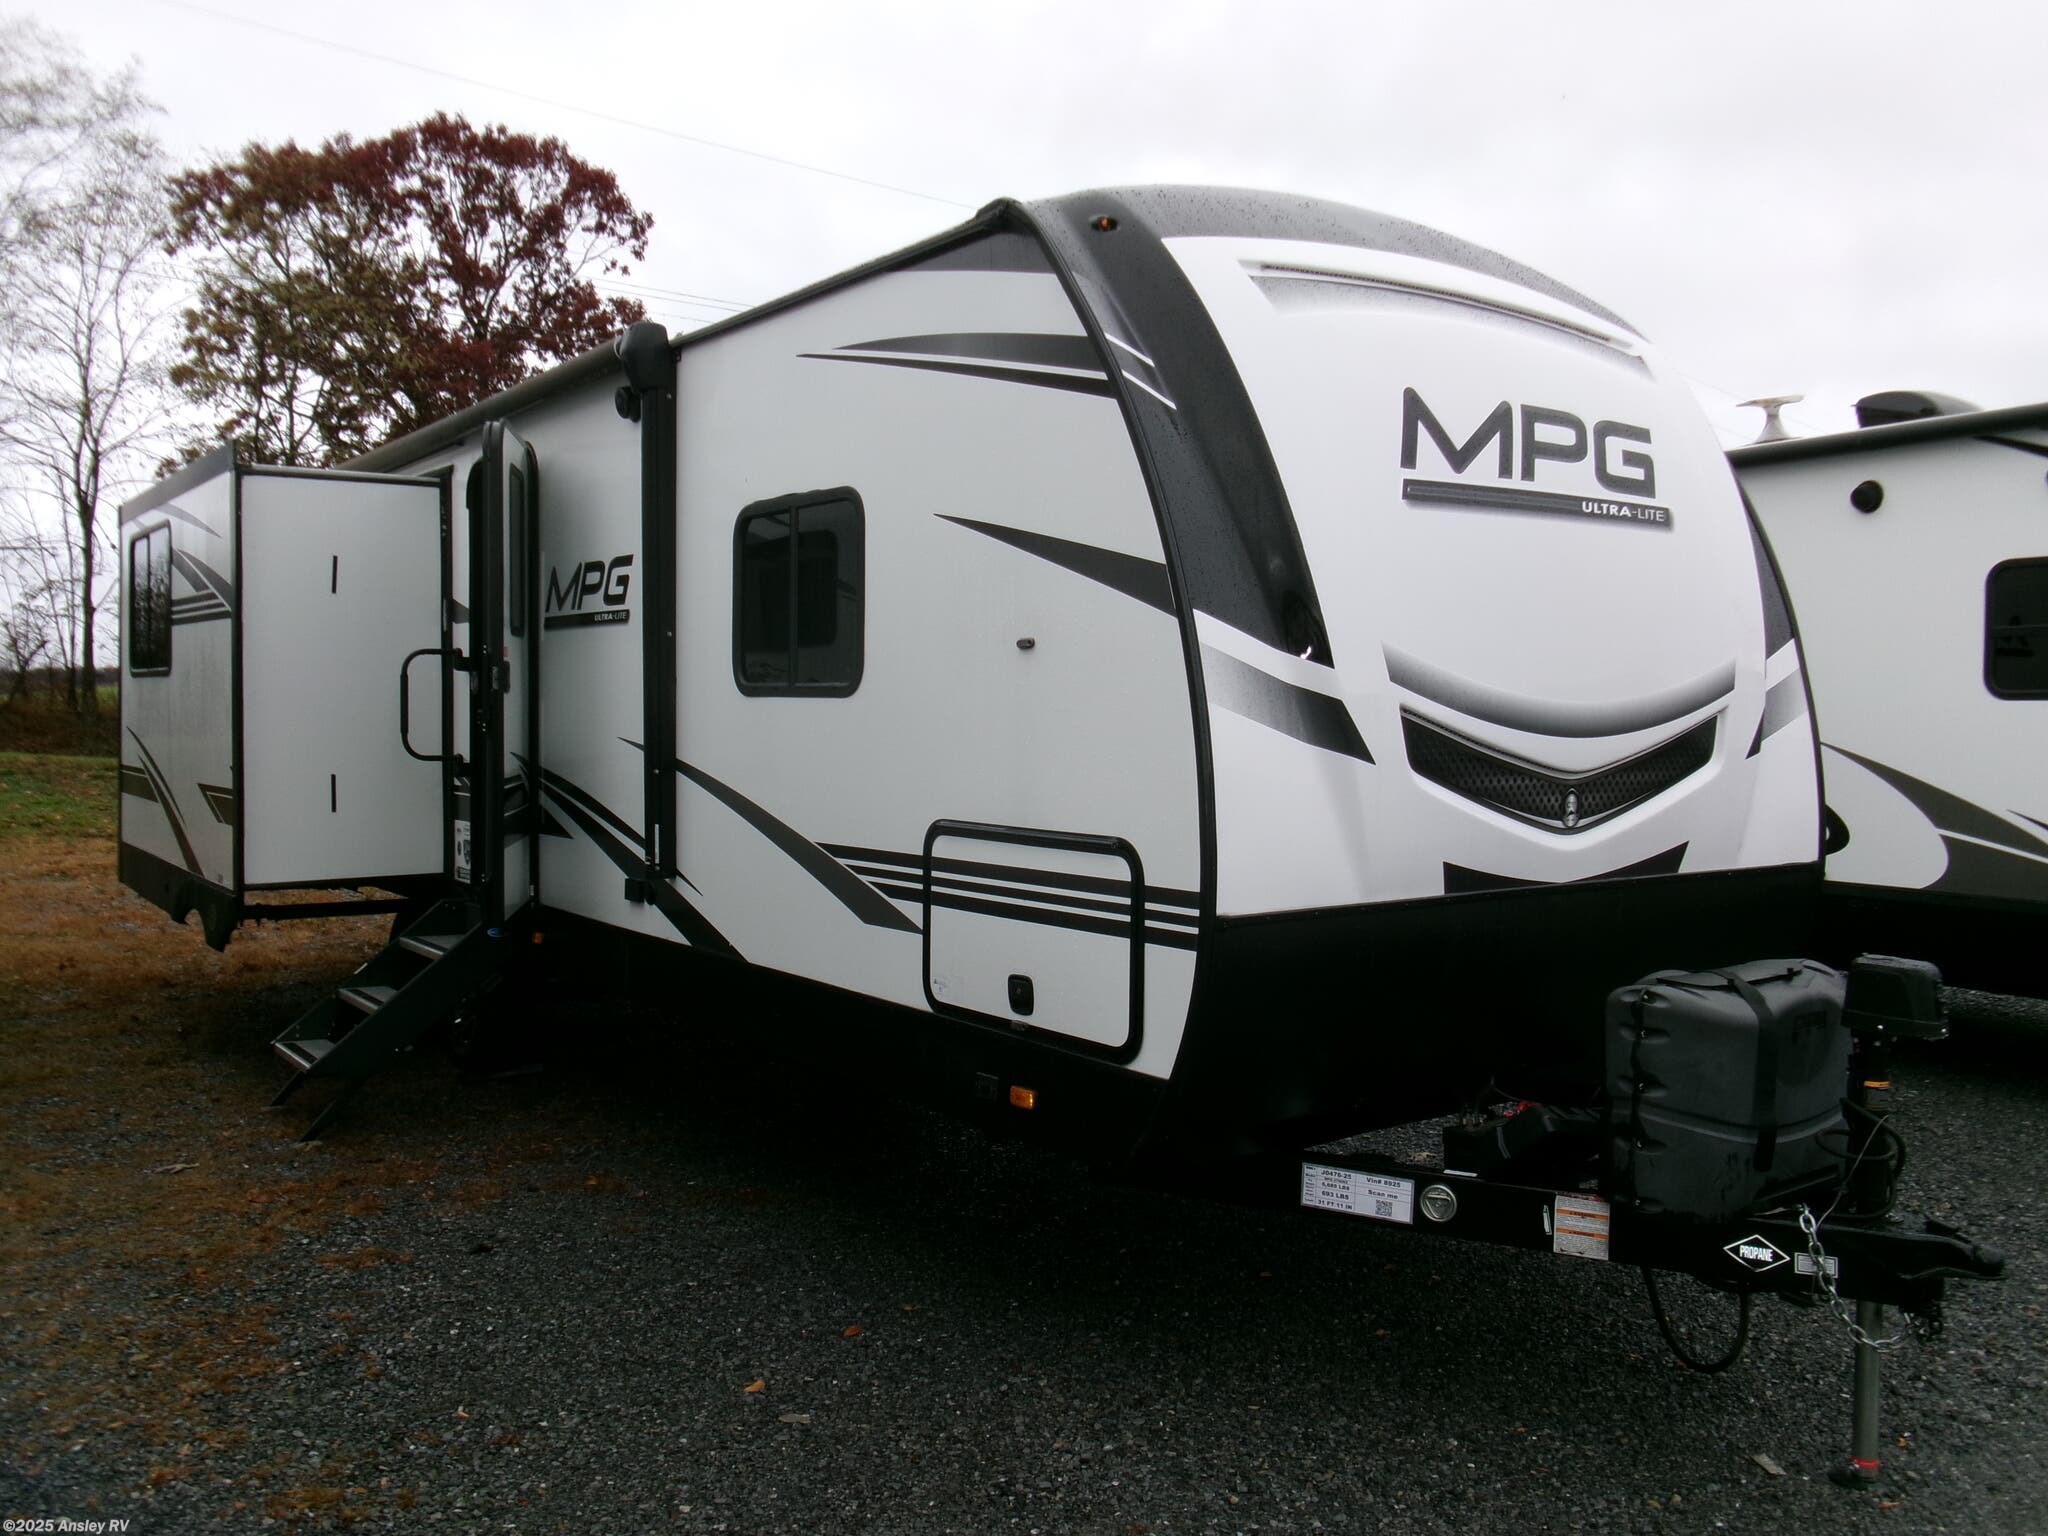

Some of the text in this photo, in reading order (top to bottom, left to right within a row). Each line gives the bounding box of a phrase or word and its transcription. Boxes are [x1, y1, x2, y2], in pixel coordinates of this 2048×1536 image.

[1400, 387, 1656, 499] MPG
[1582, 501, 1665, 522] ULTRA-LITE
[545, 554, 634, 613] MPG
[1739, 1245, 1773, 1262] PROPANE
